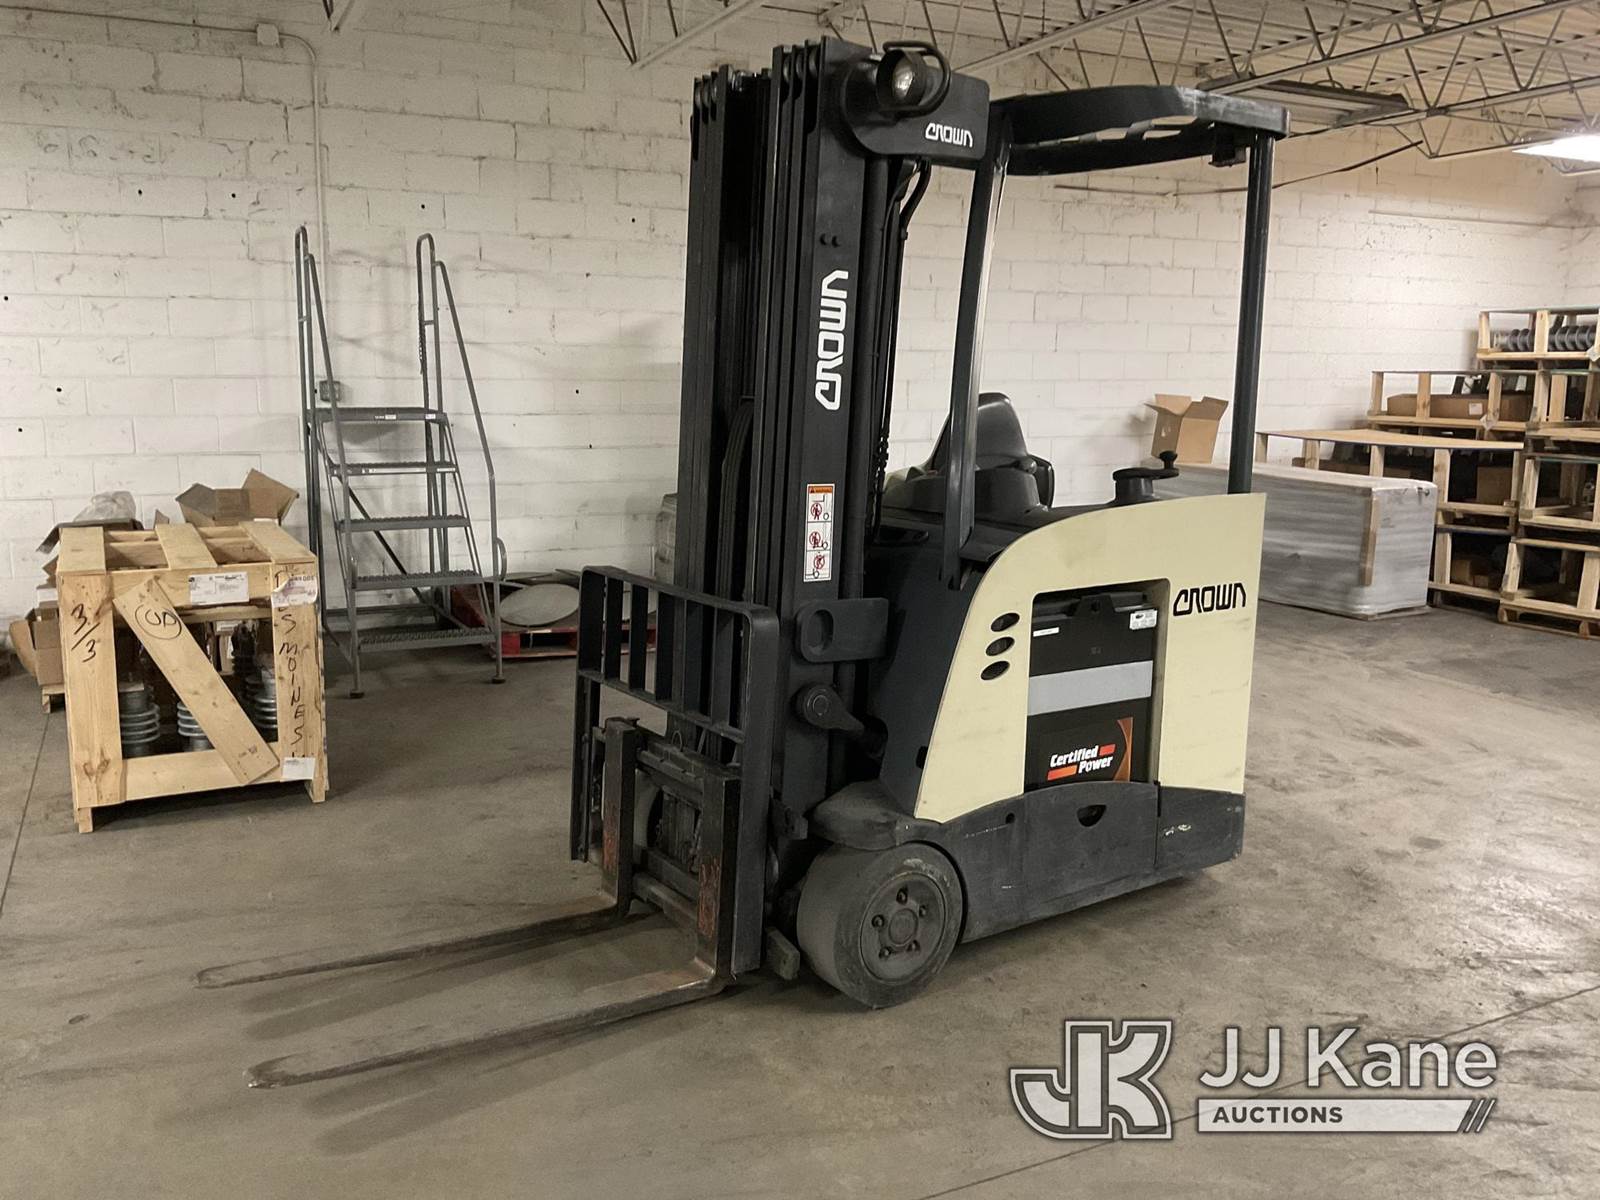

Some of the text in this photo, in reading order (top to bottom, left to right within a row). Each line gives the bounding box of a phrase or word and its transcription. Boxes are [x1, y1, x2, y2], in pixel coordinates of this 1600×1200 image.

[925, 122, 974, 148] CROWN
[815, 269, 849, 411] CROWN
[1172, 582, 1247, 617] CROWN
[1050, 745, 1099, 768] Certified
[1078, 756, 1114, 774] Power
